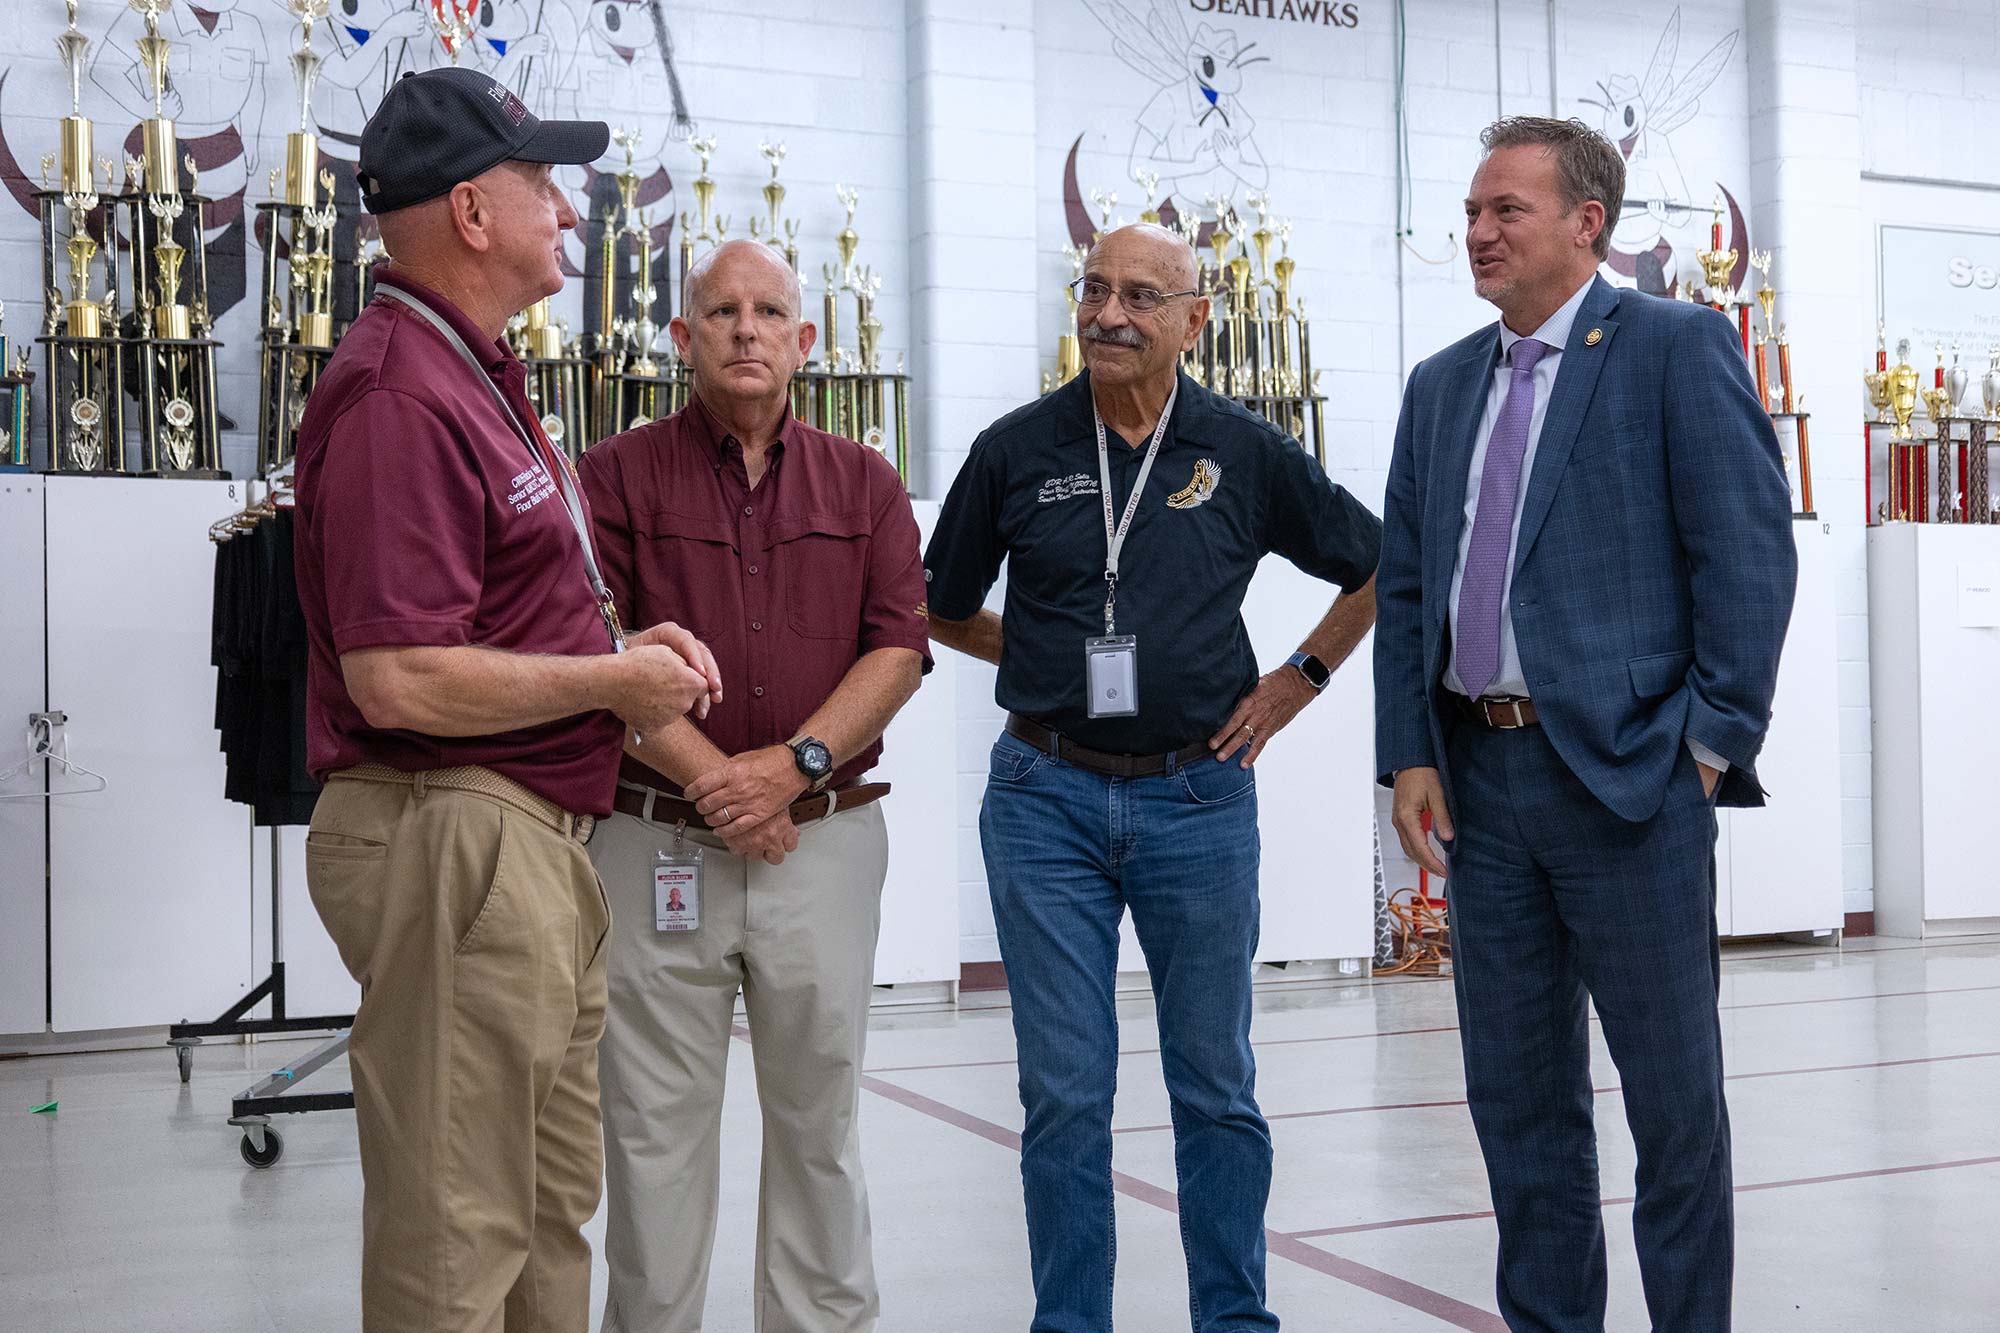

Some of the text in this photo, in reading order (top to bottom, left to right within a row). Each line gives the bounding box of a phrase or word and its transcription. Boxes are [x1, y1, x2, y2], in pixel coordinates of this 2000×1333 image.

[1149, 415, 1168, 457] YOU MATTER
[228, 484, 235, 499] 8
[1106, 508, 1114, 538] MATTER
[1119, 492, 1140, 537] YOU MATTER
[1822, 522, 1830, 535] 12
